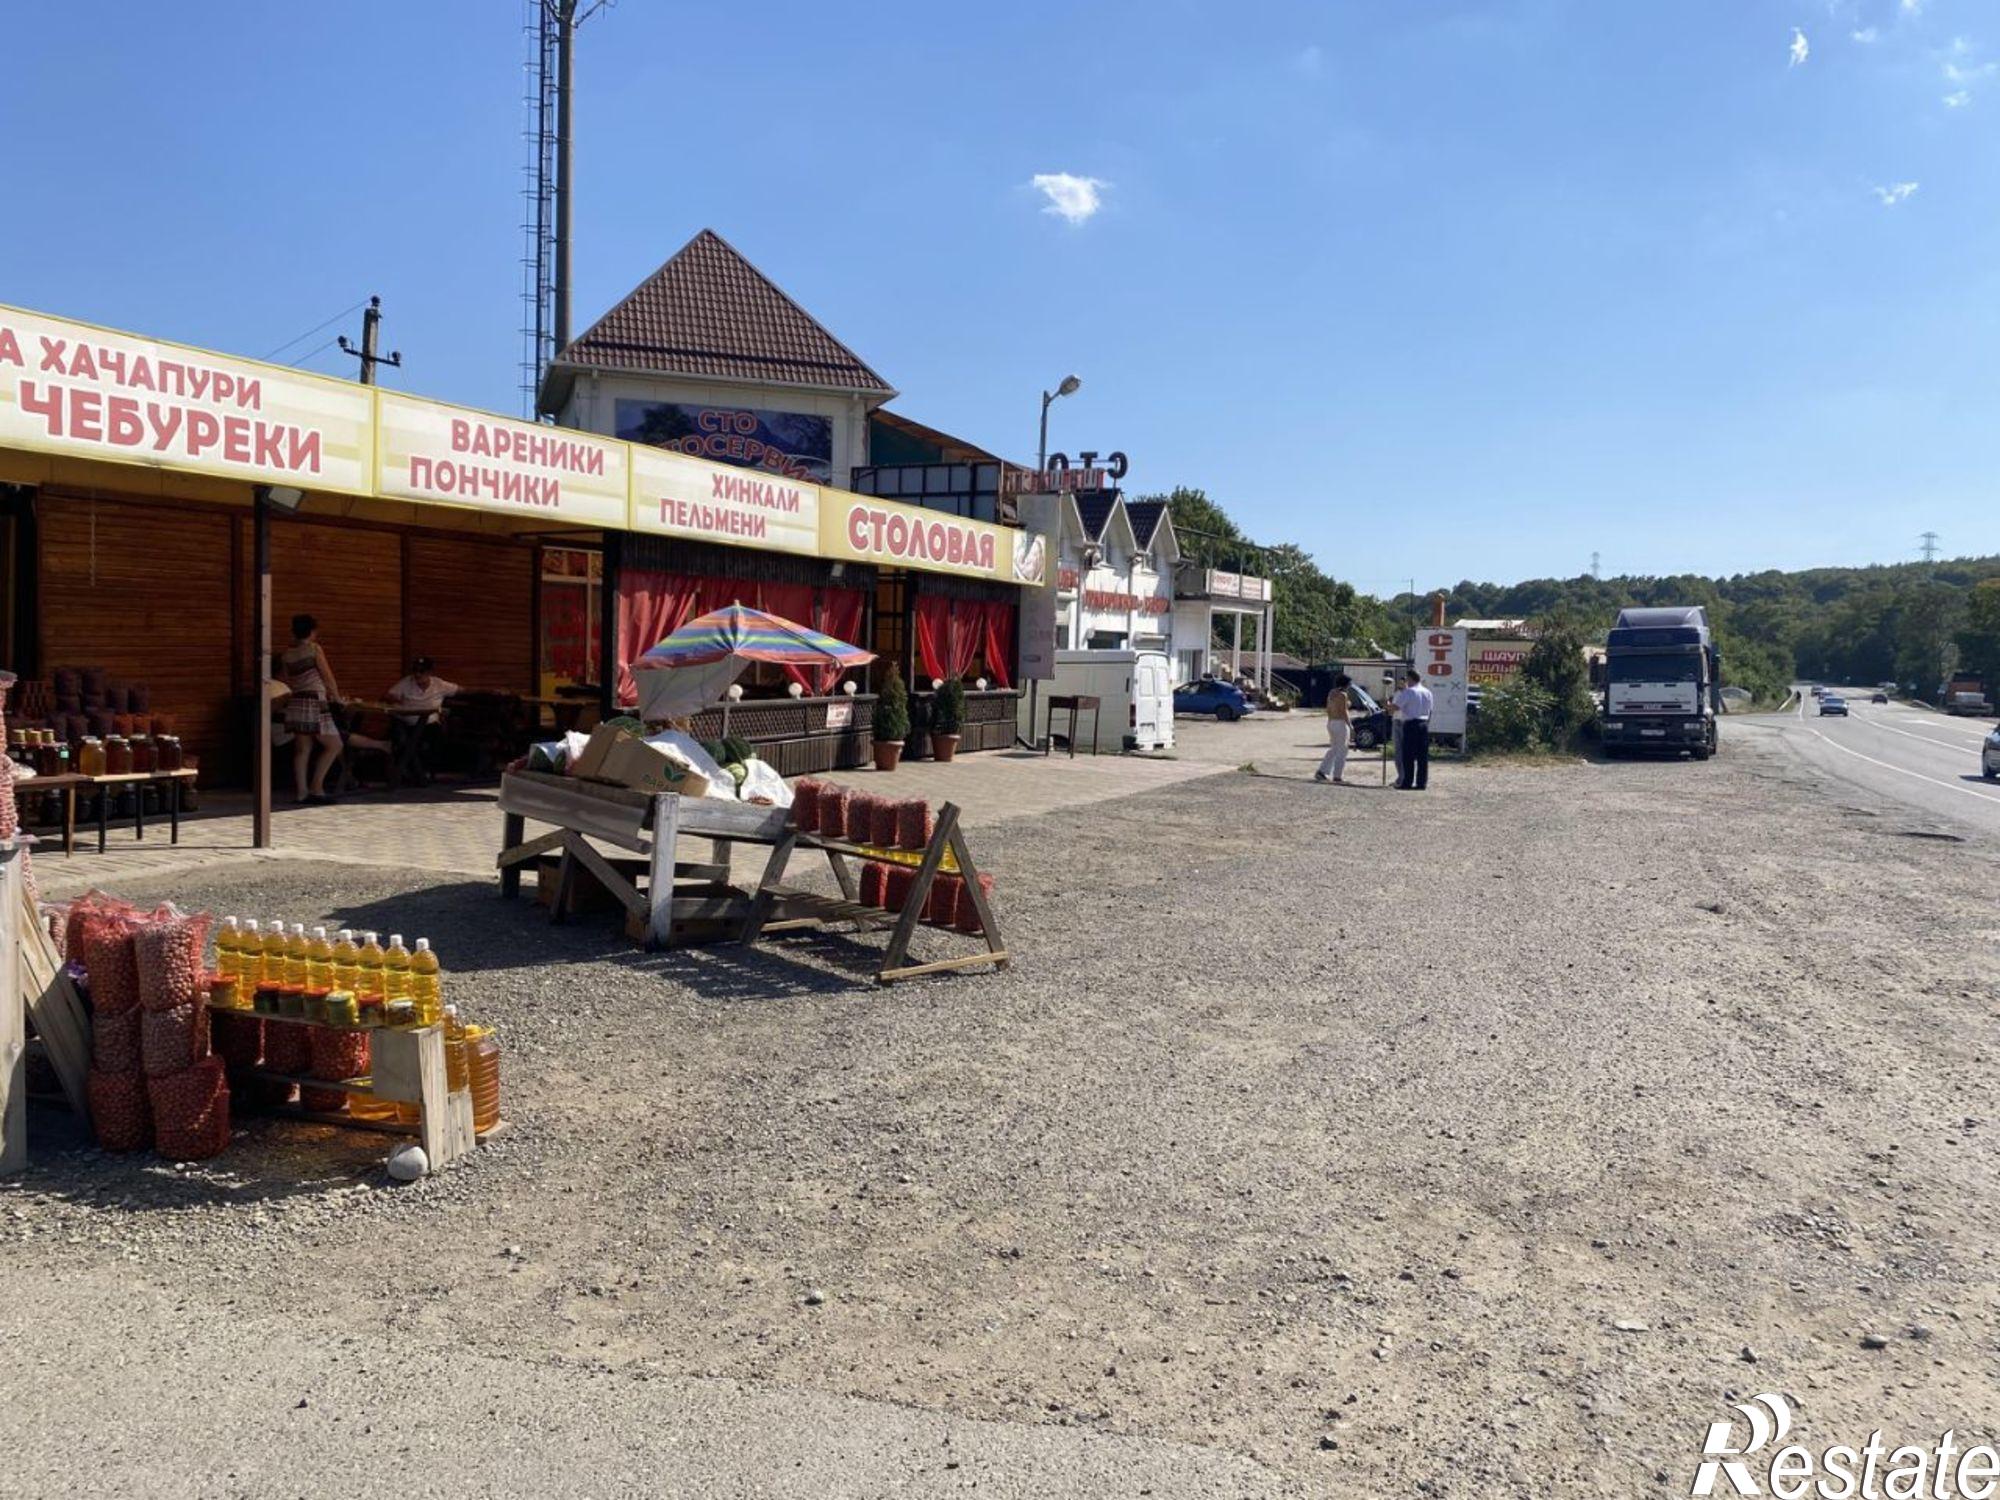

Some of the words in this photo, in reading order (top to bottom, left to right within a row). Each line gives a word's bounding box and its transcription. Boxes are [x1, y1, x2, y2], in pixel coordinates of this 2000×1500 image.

[40, 336, 261, 410] ХАЧАПУРИ
[20, 381, 321, 473] ЧЕБУРЕКИ
[452, 418, 604, 476] ВАРЕНИКИ
[698, 408, 757, 435] СТО
[410, 456, 559, 507] ПОНЧИКИ
[711, 472, 800, 514] ХИНКАЛИ
[660, 498, 766, 539] ПЕЛЬМЕНИ
[847, 506, 995, 570] СТОЛОВАЯ
[1428, 633, 1453, 676] СТО
